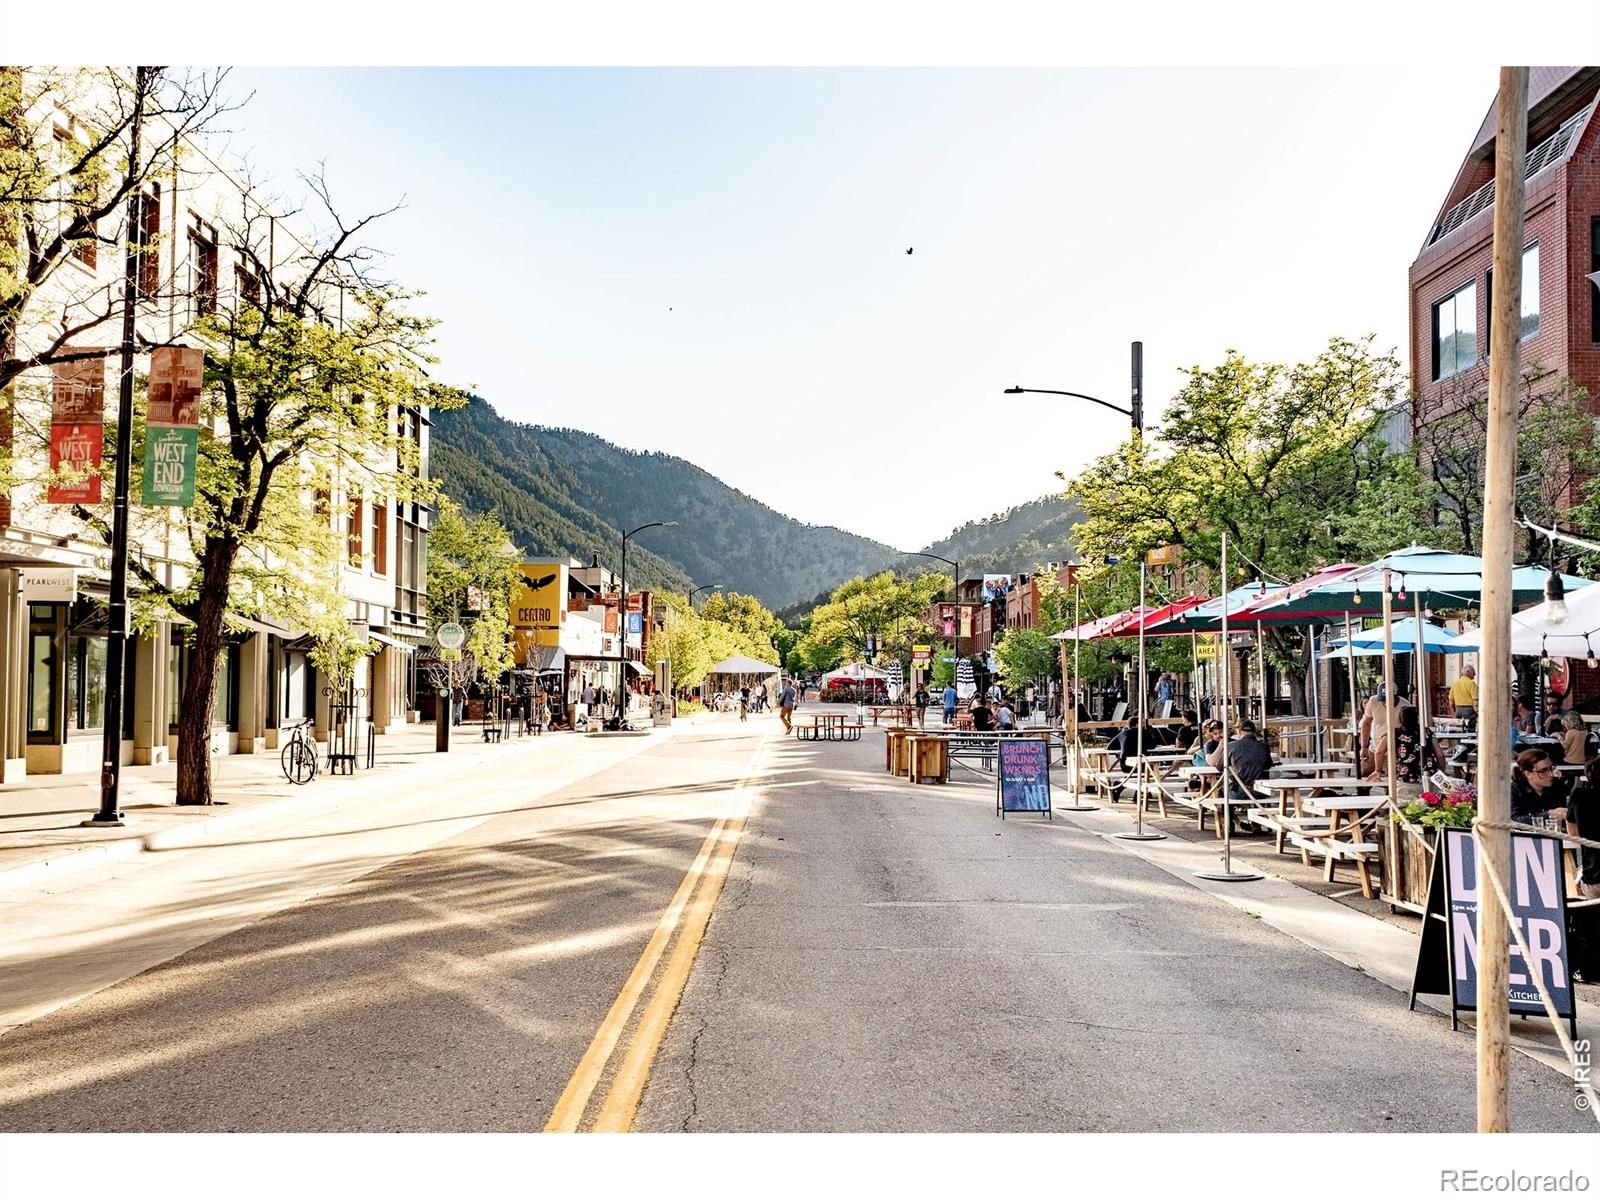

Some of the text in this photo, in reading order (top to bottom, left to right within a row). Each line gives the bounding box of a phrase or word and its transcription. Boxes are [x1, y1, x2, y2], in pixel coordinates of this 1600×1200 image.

[60, 441, 93, 460] WEST
[154, 442, 188, 463] WEST
[154, 462, 184, 484] END
[518, 607, 551, 622] CENTRO
[1198, 647, 1215, 655] AHEA
[1004, 744, 1043, 754] BRUNCH
[1004, 755, 1037, 764] DRUNK
[1005, 765, 1042, 774] WKNDS
[1448, 831, 1558, 909] DN
